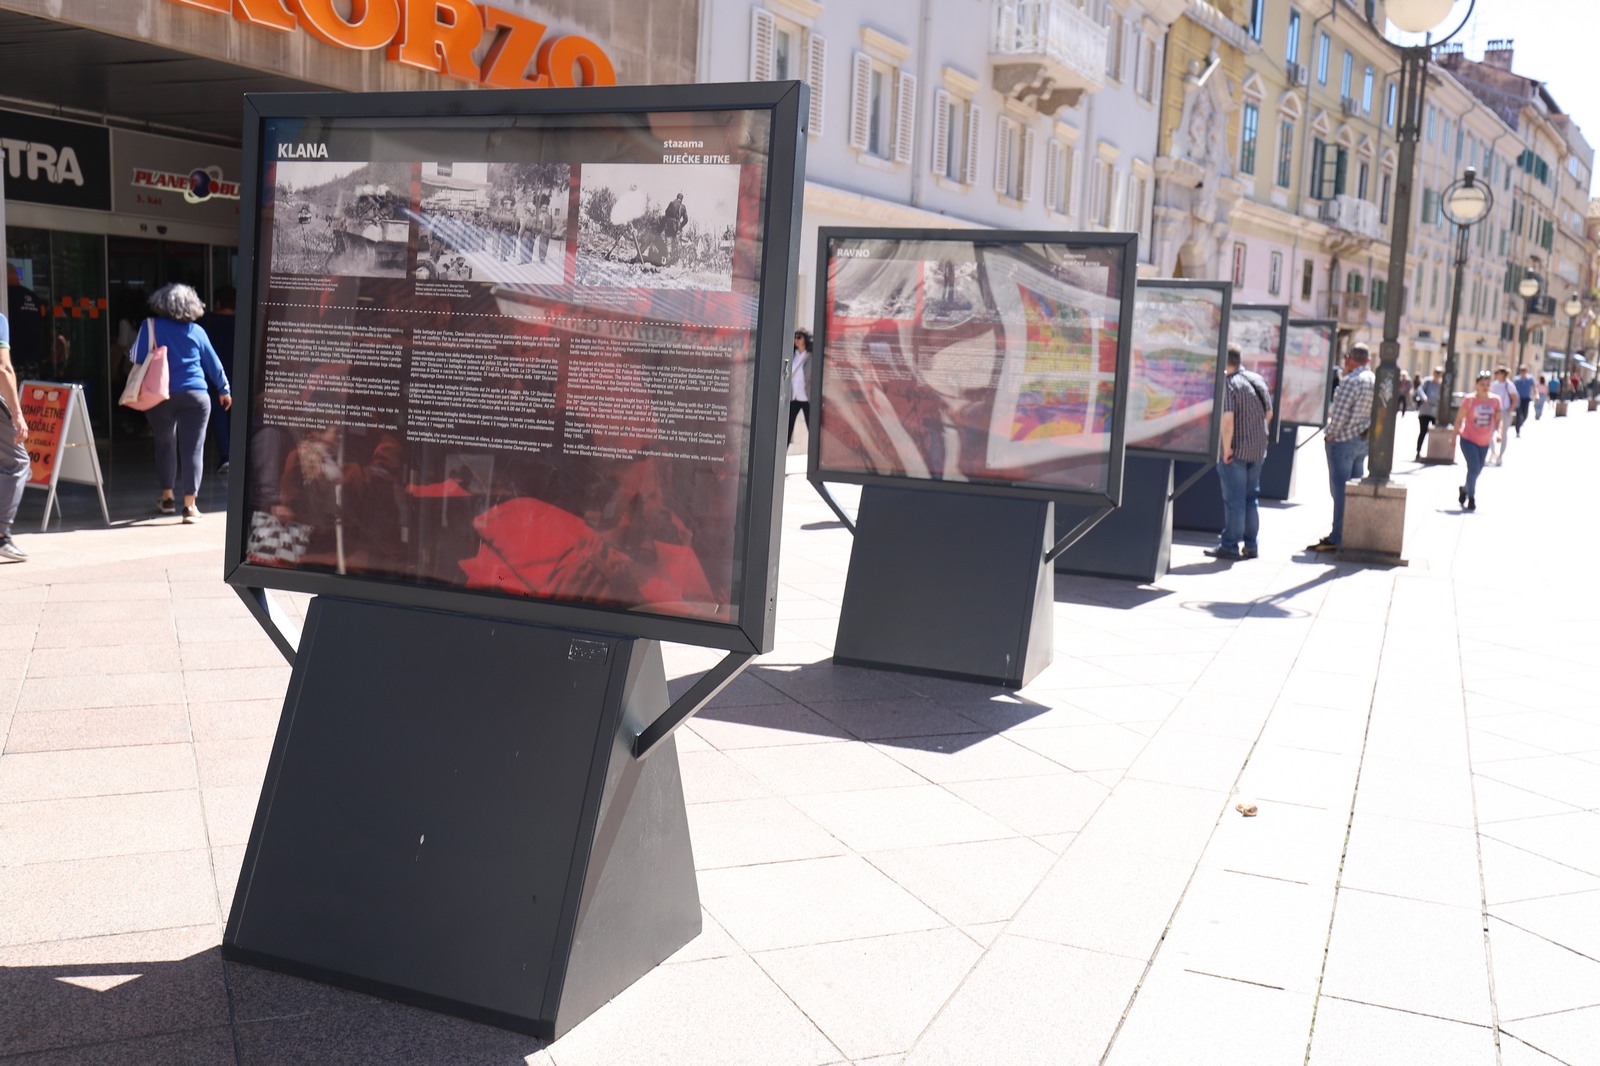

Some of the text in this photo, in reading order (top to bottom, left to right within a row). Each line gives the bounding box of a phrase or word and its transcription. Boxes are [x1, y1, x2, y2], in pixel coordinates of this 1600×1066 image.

[278, 143, 329, 158] KLANA
[663, 139, 704, 148] stazama
[0, 138, 84, 186] TRA
[663, 153, 730, 164] RIJEČKE BITKE
[134, 169, 196, 192] PLANET
[837, 248, 870, 258] RAVNO
[26, 419, 56, 433] AOČALE
